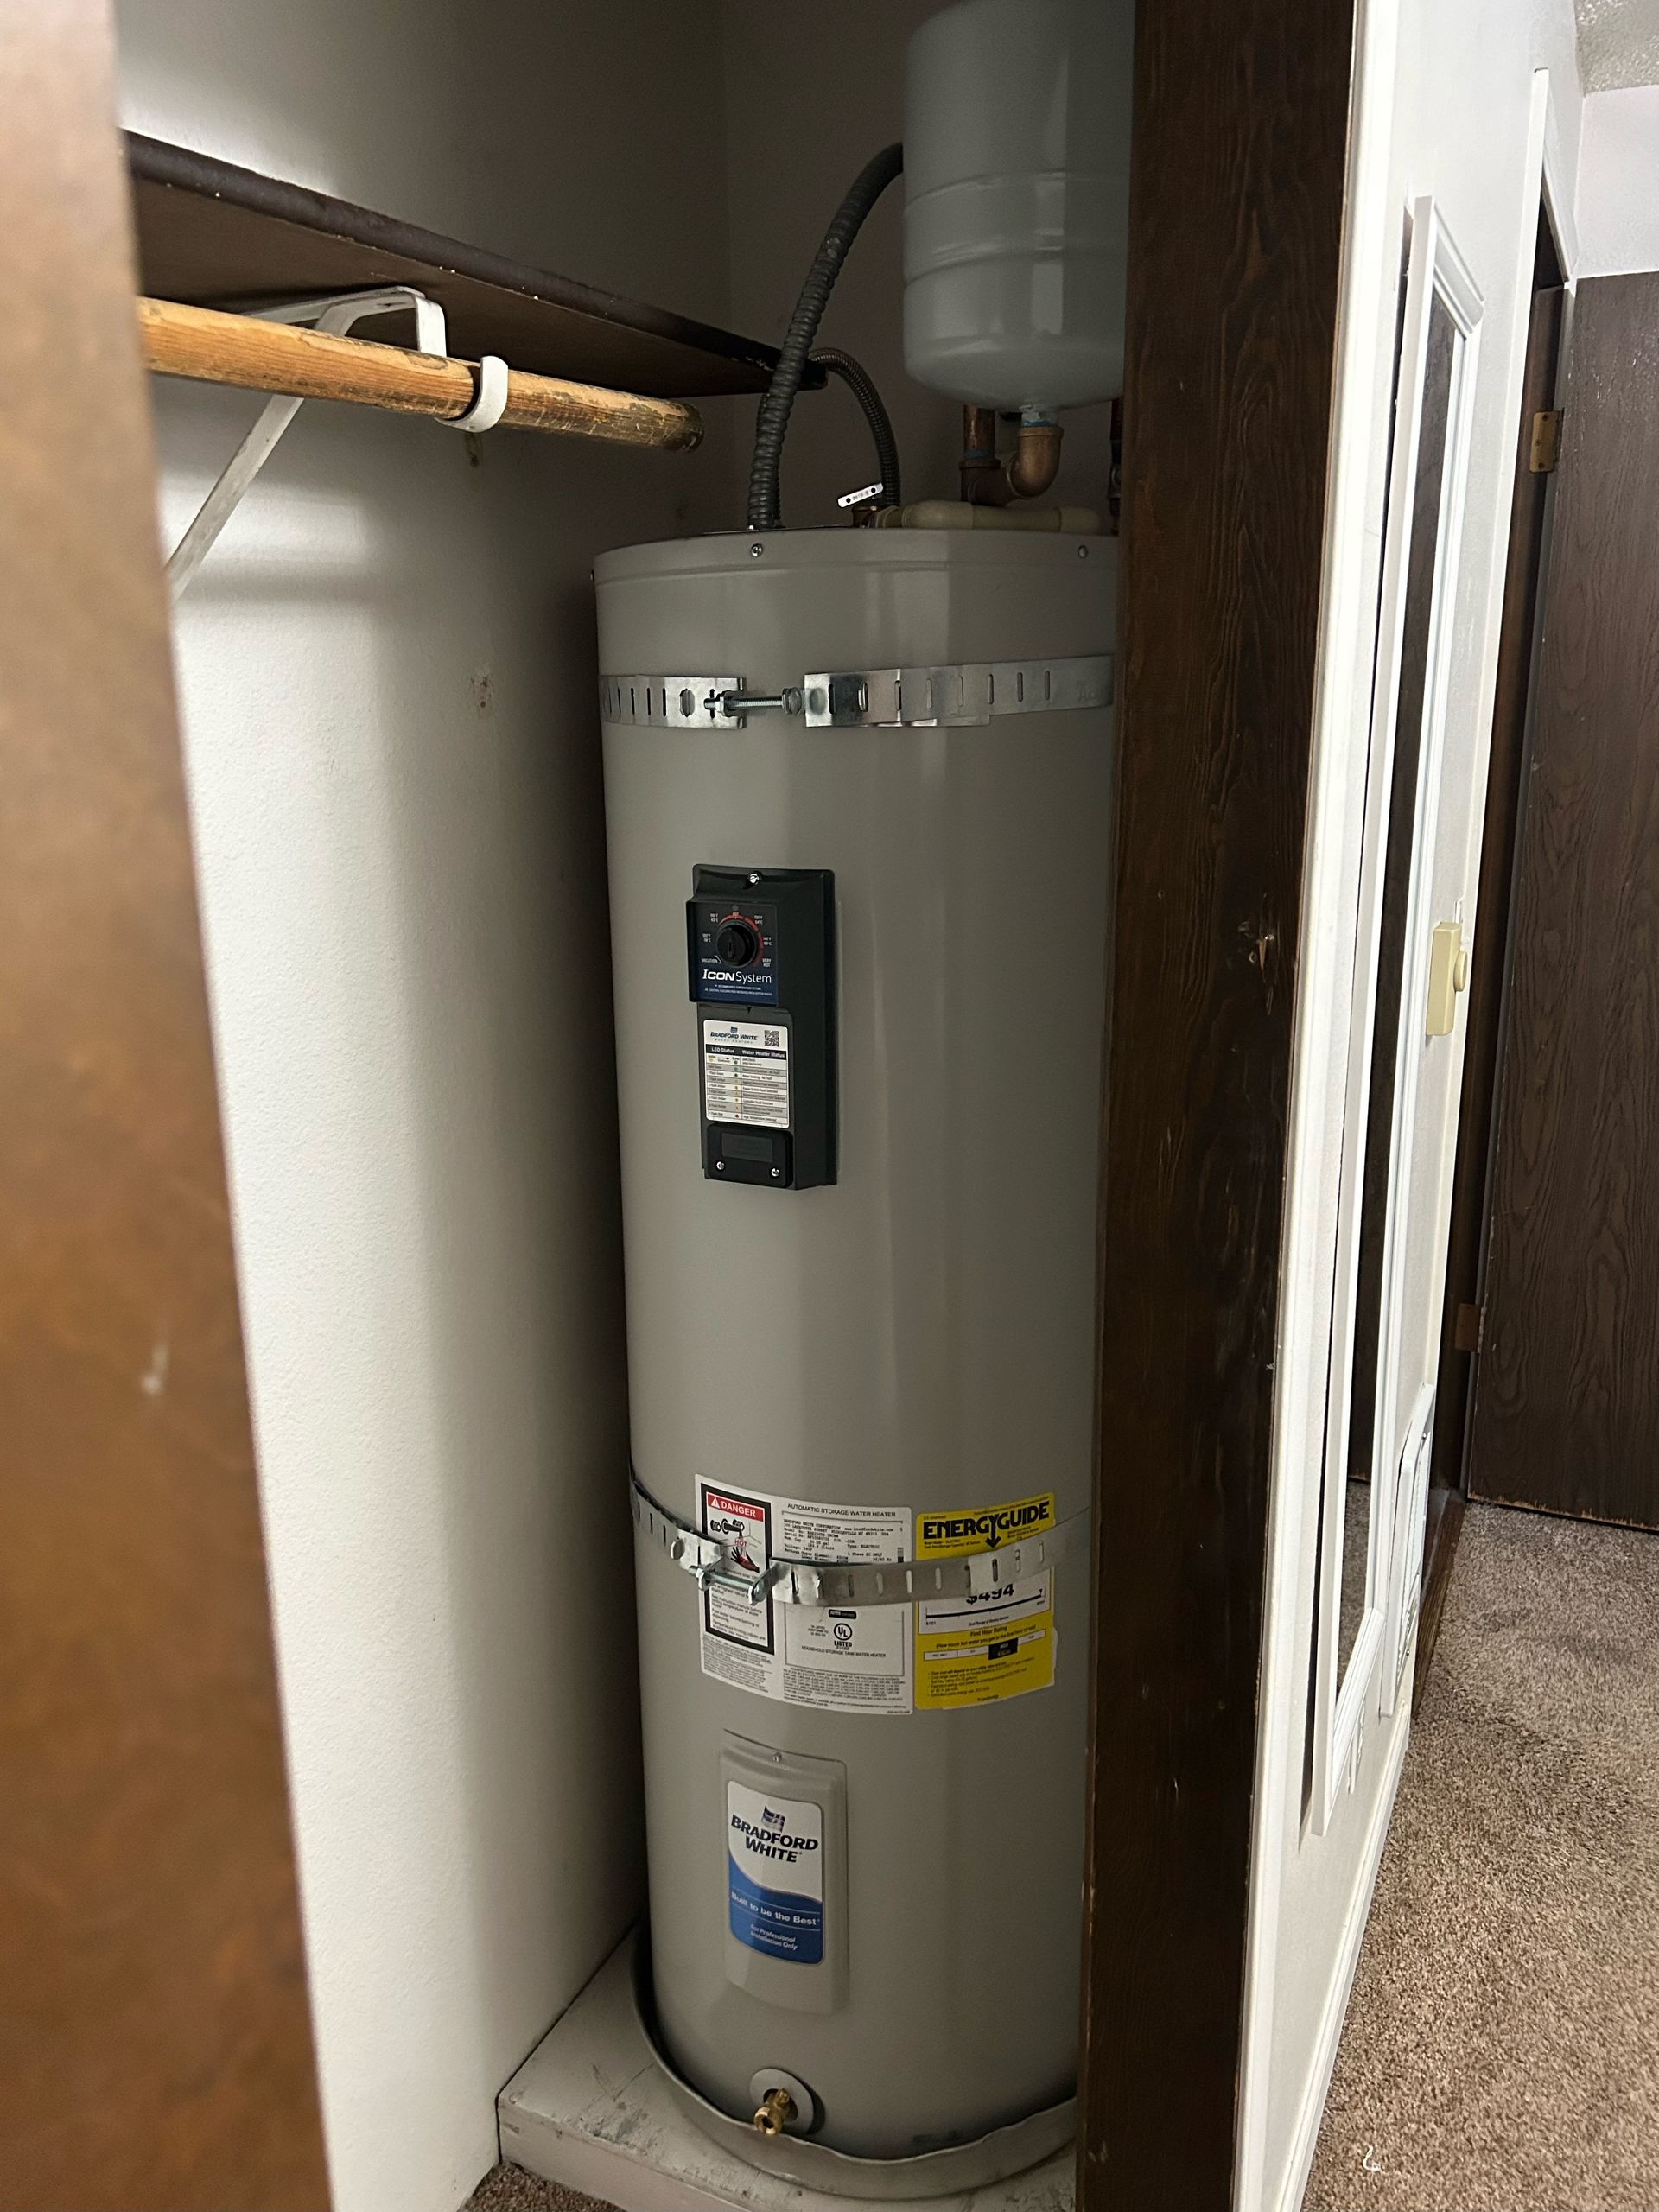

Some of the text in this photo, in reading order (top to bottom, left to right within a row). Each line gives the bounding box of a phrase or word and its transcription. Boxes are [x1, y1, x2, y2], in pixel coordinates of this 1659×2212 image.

[710, 1031, 739, 1039] BRADFORD
[721, 1501, 756, 1518] DANGER
[787, 1503, 820, 1513] AUTOMATIC
[923, 1501, 1049, 1547] ENERGYGUIDE
[838, 1626, 848, 1637] UL
[731, 1815, 818, 1851] BRADFORD
[745, 1835, 798, 1863] WHITE
[731, 1891, 817, 1926] Built to be the Best
[750, 1923, 796, 1942] For Professional
[750, 1932, 798, 1951] Installation Only
